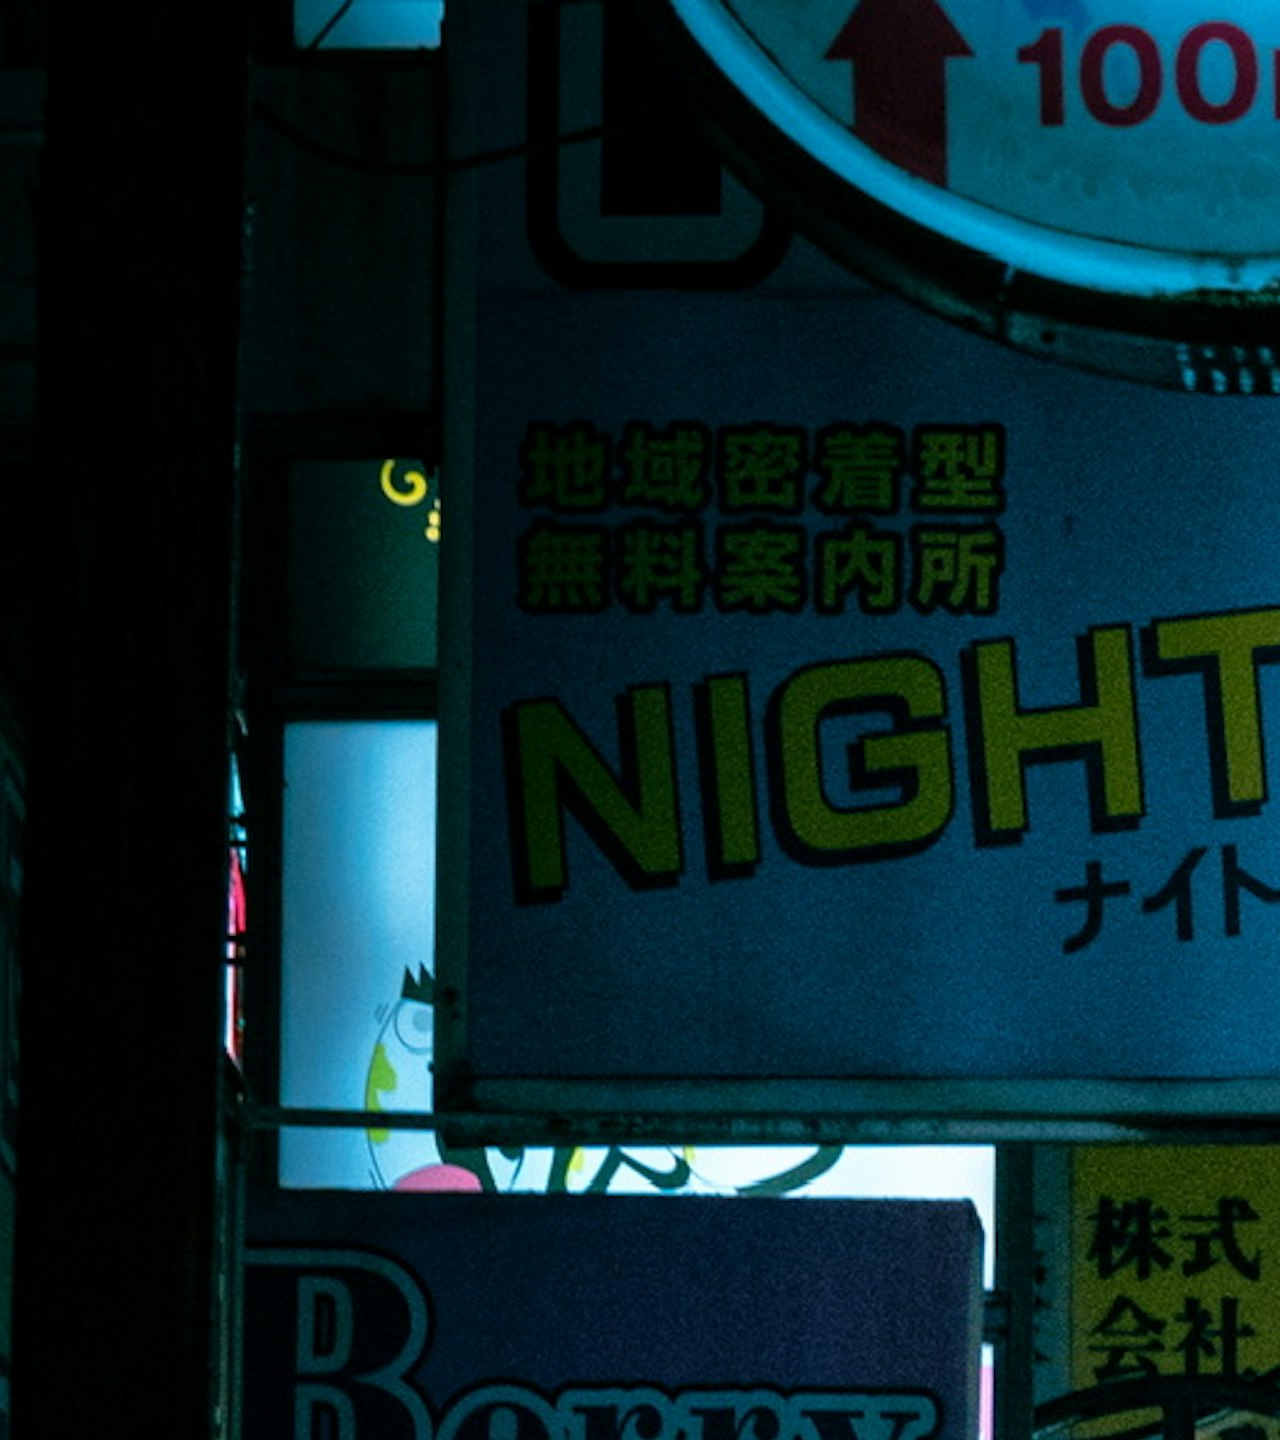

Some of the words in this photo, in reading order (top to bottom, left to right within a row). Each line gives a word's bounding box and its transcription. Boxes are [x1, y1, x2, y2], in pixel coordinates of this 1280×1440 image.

[520, 420, 1005, 515] 地域密着型
[518, 526, 1003, 615] 無料案内所
[1087, 1196, 1262, 1280] 株式
